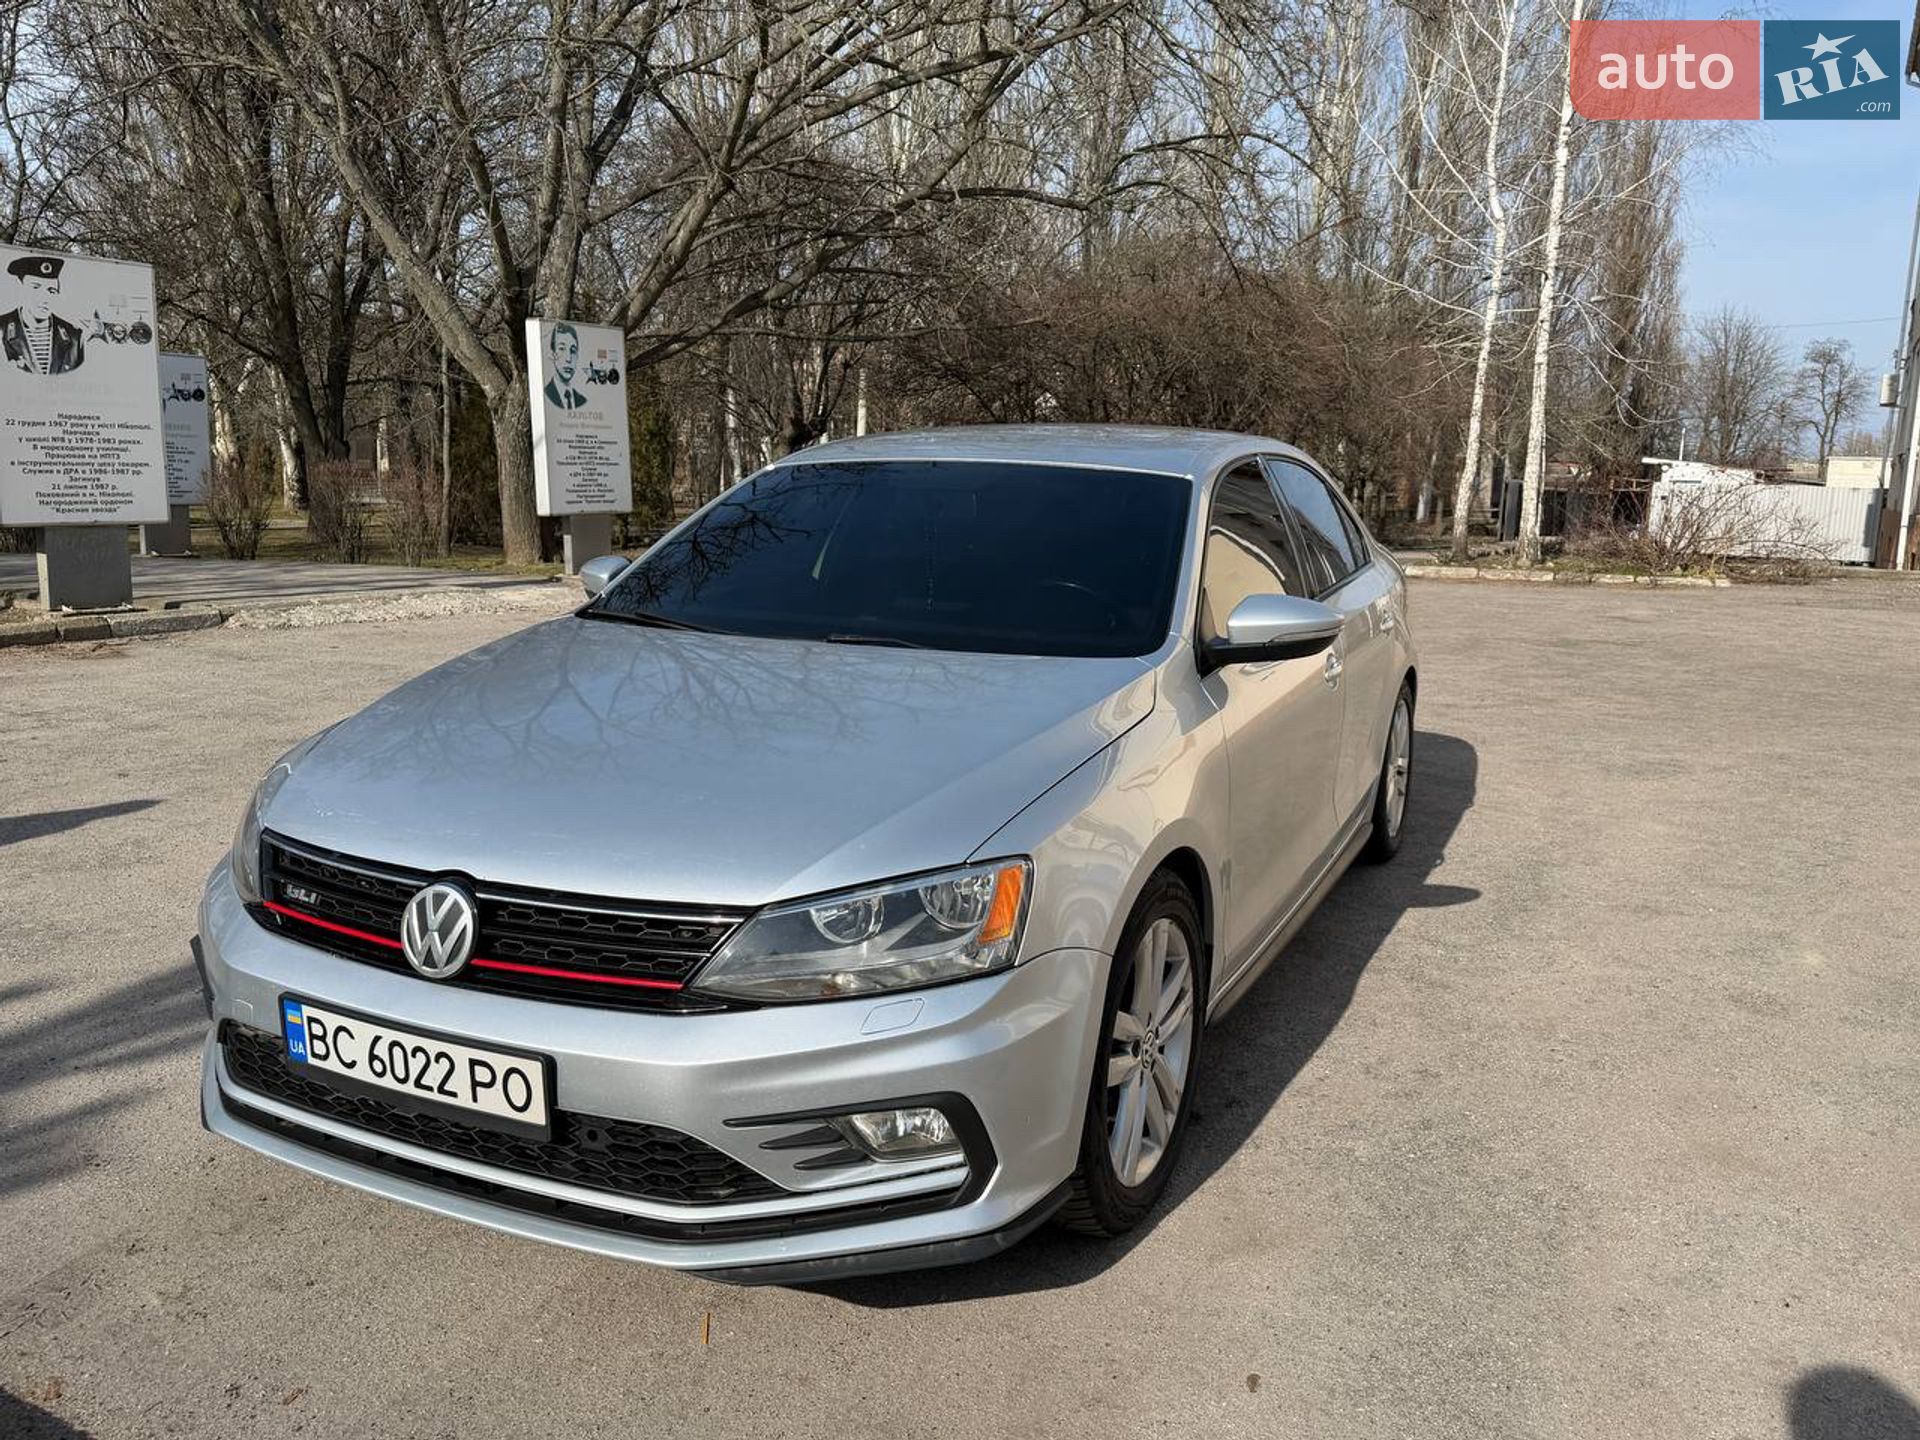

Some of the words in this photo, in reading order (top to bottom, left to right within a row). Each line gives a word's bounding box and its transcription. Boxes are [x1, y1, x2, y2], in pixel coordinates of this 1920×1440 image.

[5, 418, 15, 426] 22
[289, 1039, 306, 1056] UA
[306, 1015, 357, 1069] BC
[367, 1035, 459, 1098] 6022
[468, 1057, 532, 1113] PO
